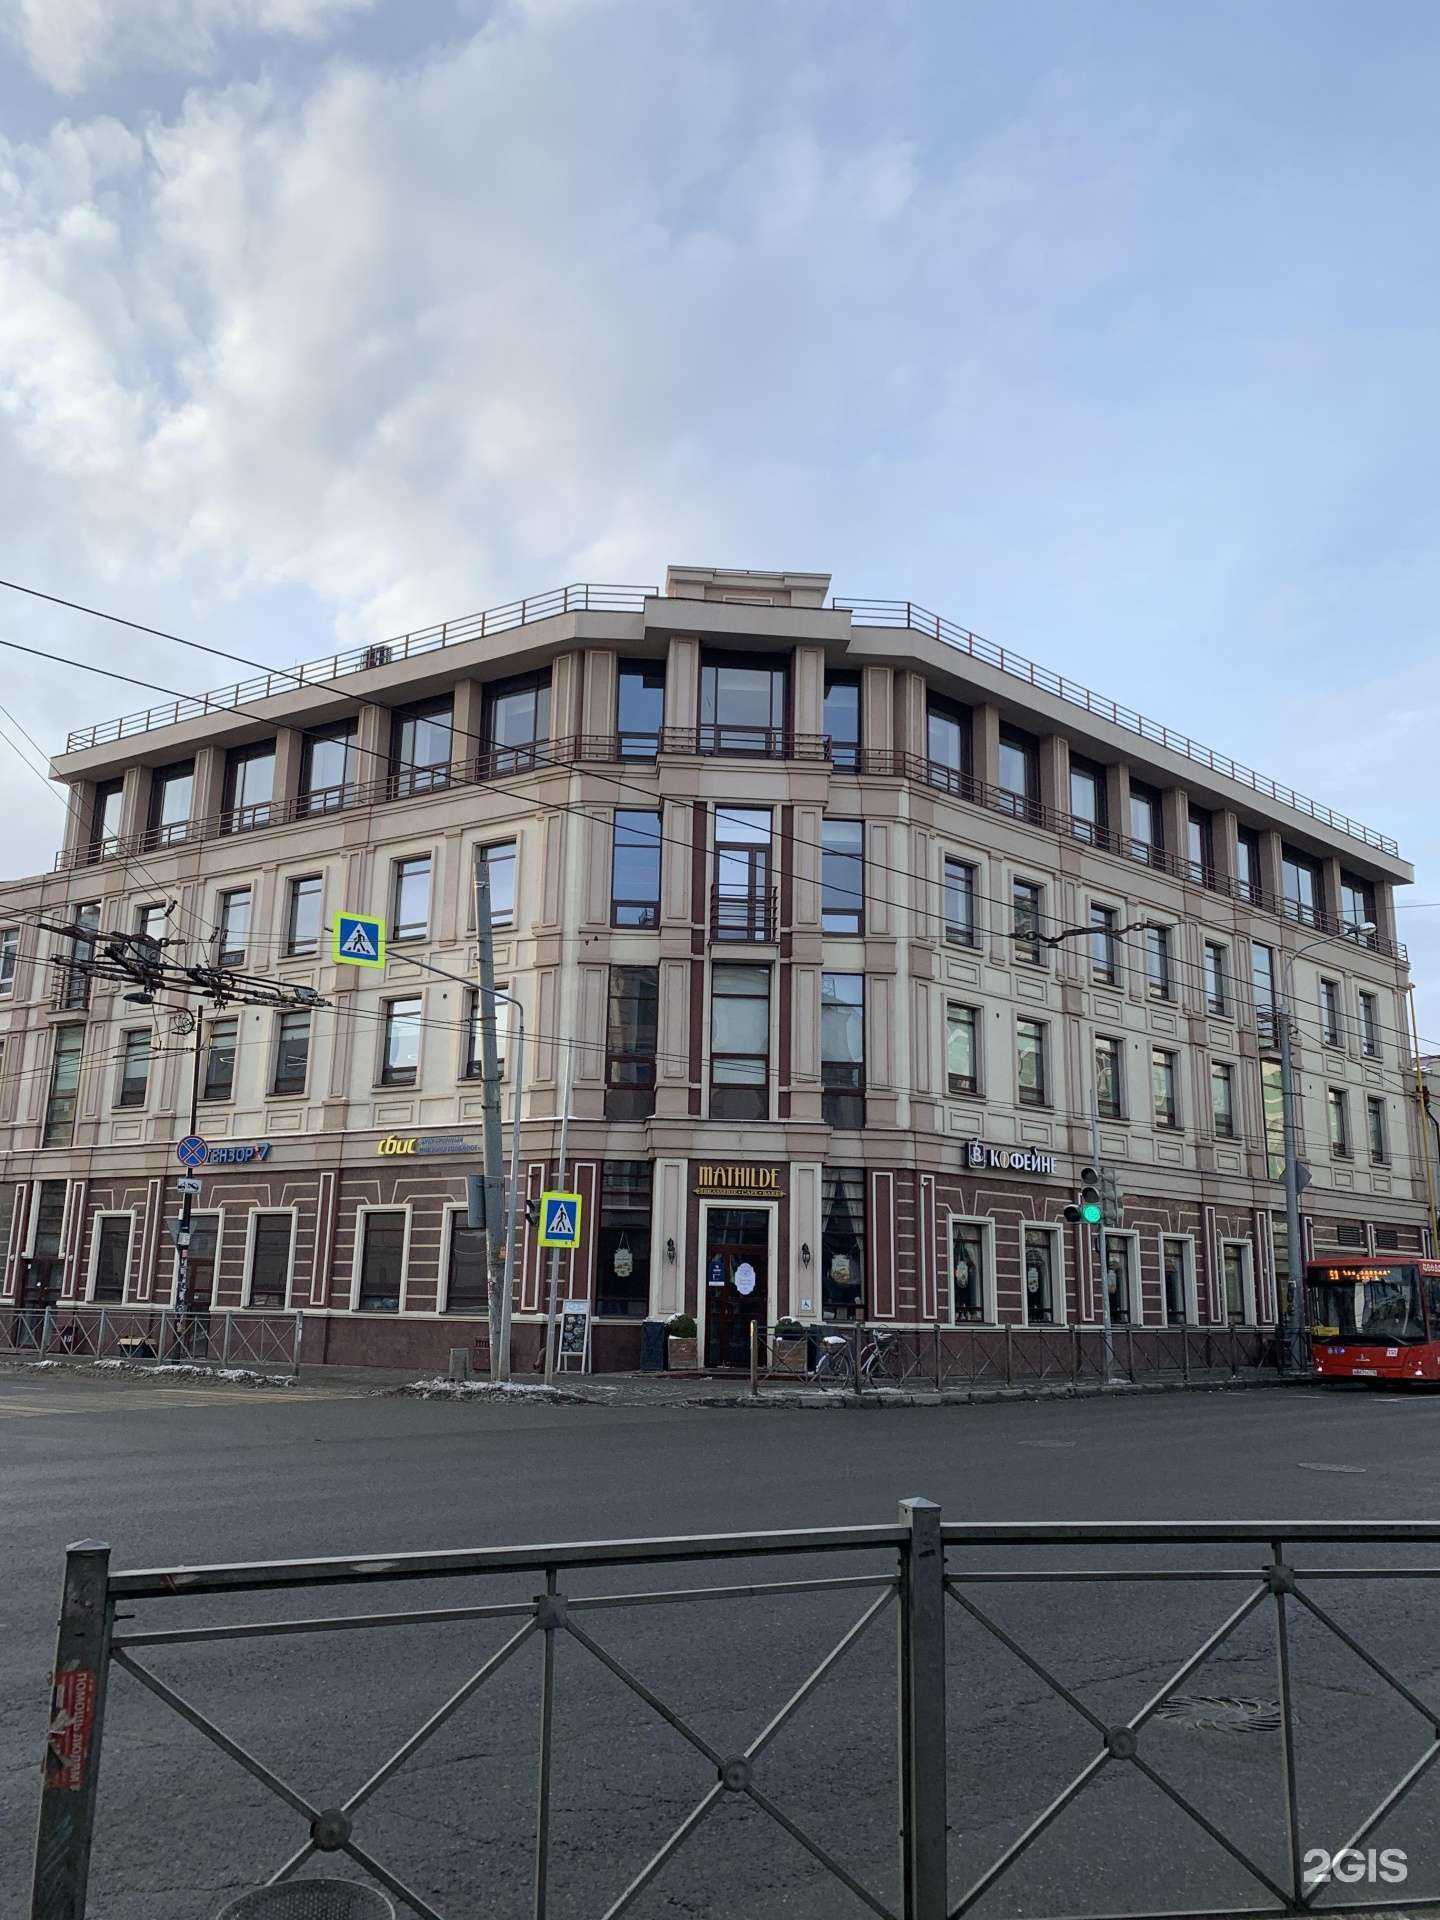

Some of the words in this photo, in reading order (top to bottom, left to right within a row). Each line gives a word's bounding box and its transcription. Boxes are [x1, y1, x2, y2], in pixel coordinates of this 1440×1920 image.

[990, 1146, 1057, 1174] КОФЕЙНЕ
[698, 1166, 782, 1188] MATHILDE
[73, 1673, 88, 1729] ПОМОЩЬ
